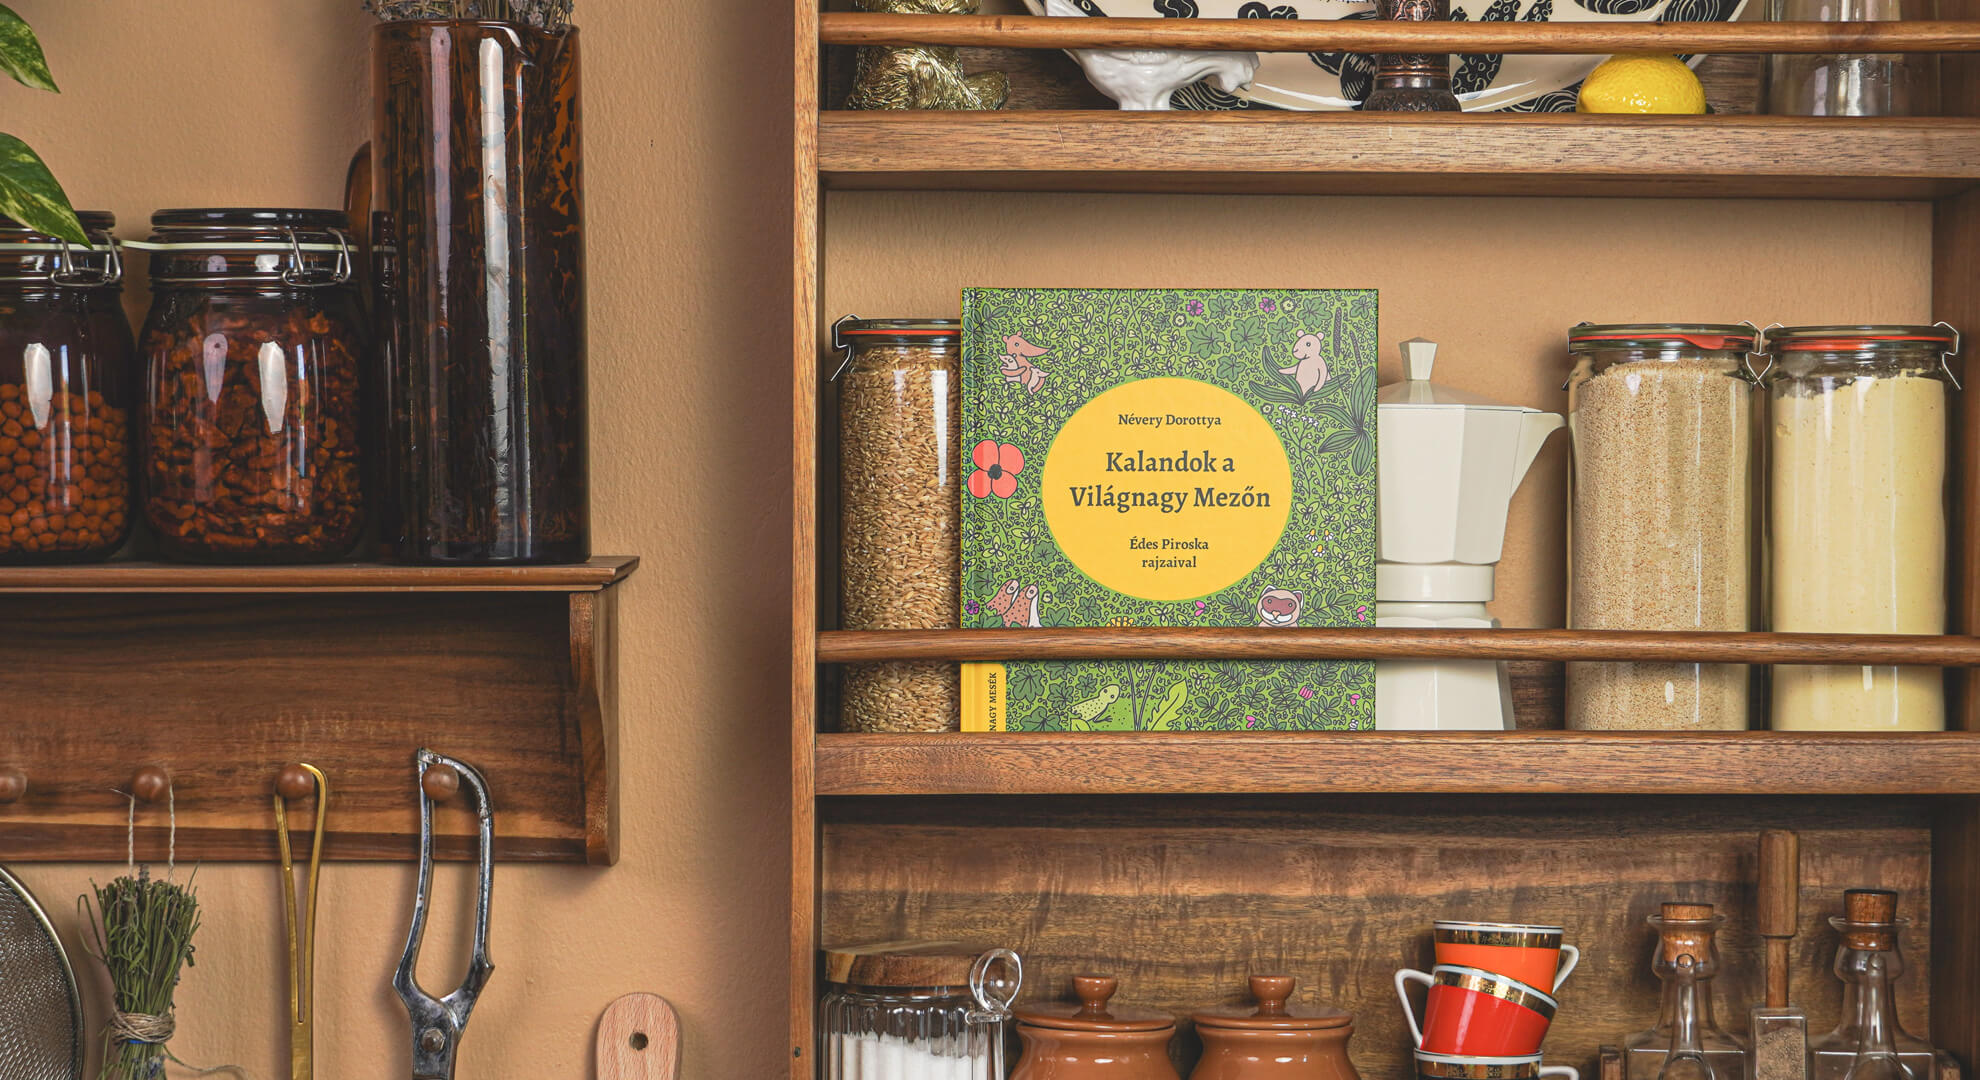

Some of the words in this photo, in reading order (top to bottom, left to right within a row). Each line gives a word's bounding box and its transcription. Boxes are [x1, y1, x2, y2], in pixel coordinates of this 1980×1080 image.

[1118, 413, 1163, 429] Névery
[1166, 414, 1222, 429] Dorottya
[1105, 449, 1217, 473] Kalandok
[1222, 457, 1236, 473] a
[1069, 484, 1189, 514] Világnagy
[1193, 485, 1271, 508] Mezőn
[1129, 535, 1159, 550] Édes
[1162, 537, 1209, 550] Piroska
[1142, 555, 1197, 571] rajzaival
[987, 672, 997, 704] MESÉK
